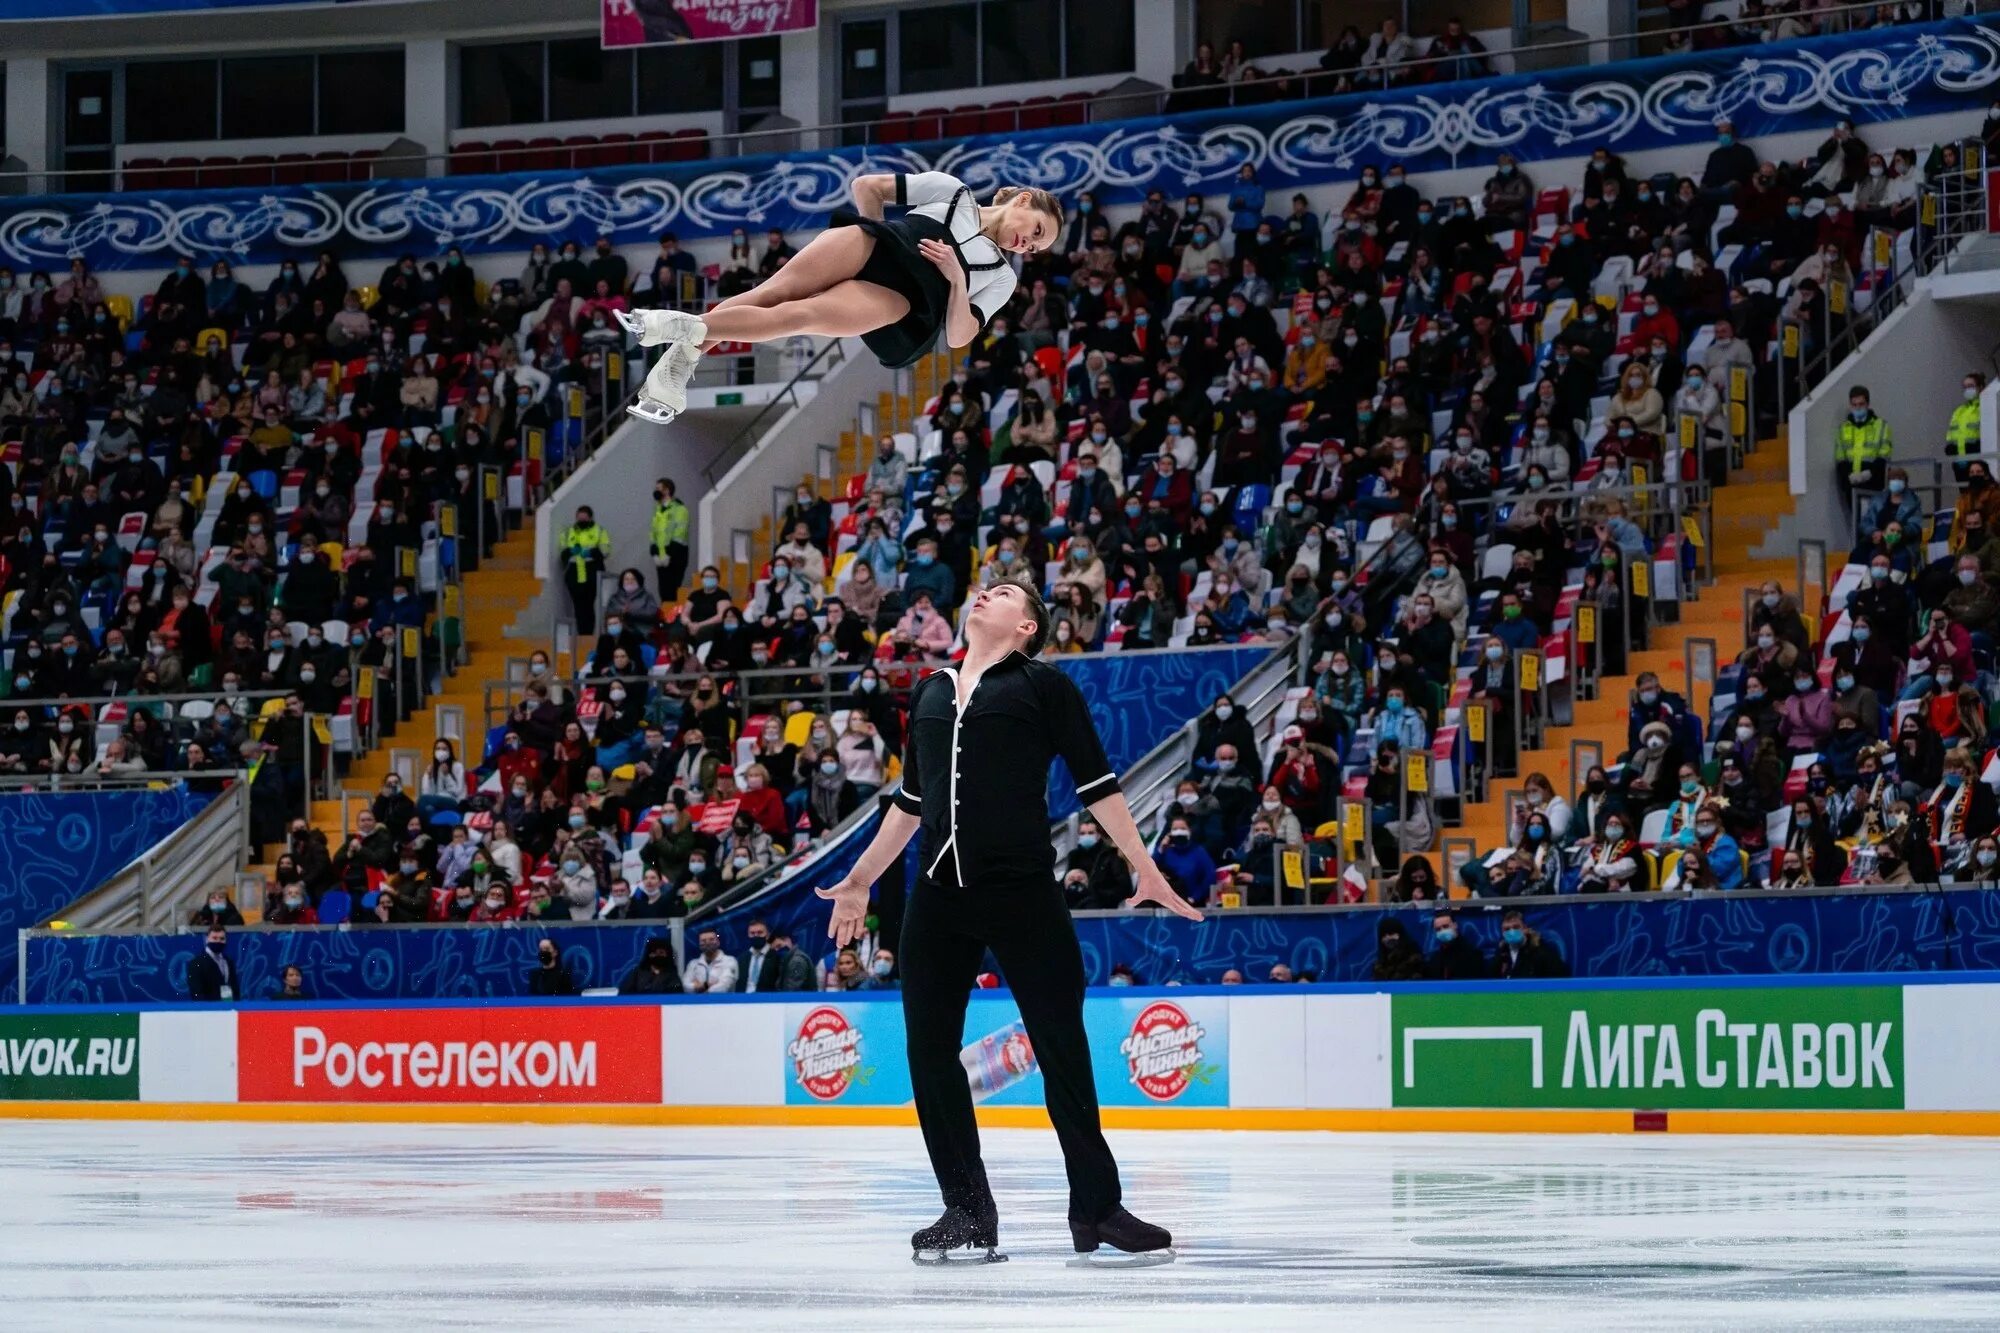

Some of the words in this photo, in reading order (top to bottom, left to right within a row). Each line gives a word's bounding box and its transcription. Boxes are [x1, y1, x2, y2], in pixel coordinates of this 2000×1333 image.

[293, 1025, 597, 1088] Ростелеком
[788, 1027, 862, 1061] Чистая
[1121, 1023, 1205, 1060] Чистая
[1561, 1009, 1686, 1088] Лига
[1695, 1008, 1894, 1088] Ставок
[1129, 1046, 1203, 1084] Линия
